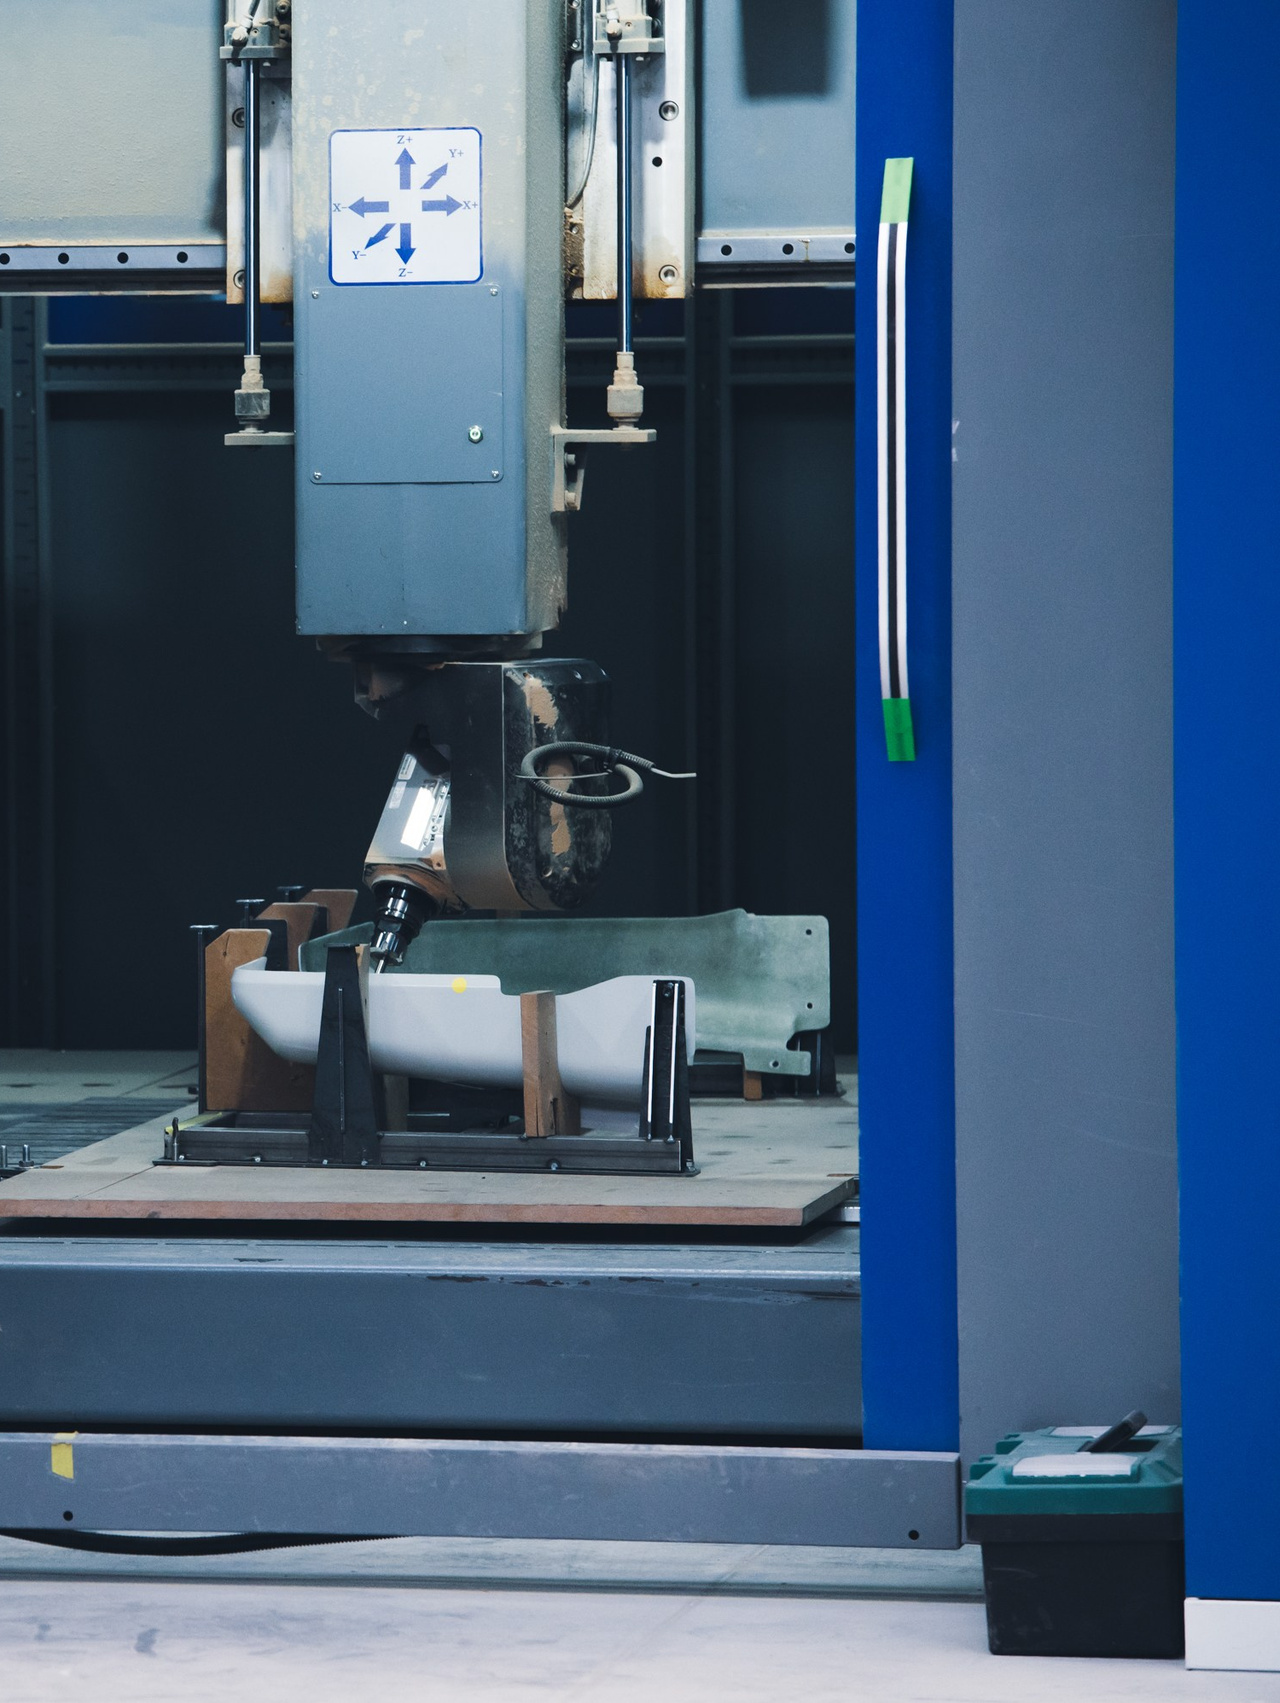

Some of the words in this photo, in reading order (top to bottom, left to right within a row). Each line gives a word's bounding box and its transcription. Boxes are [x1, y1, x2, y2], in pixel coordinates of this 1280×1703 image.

[396, 135, 413, 144] Z+
[448, 149, 464, 158] Y+
[332, 203, 348, 212] X-
[462, 201, 478, 210] X+
[352, 250, 366, 260] Y-
[398, 268, 413, 278] Z-
